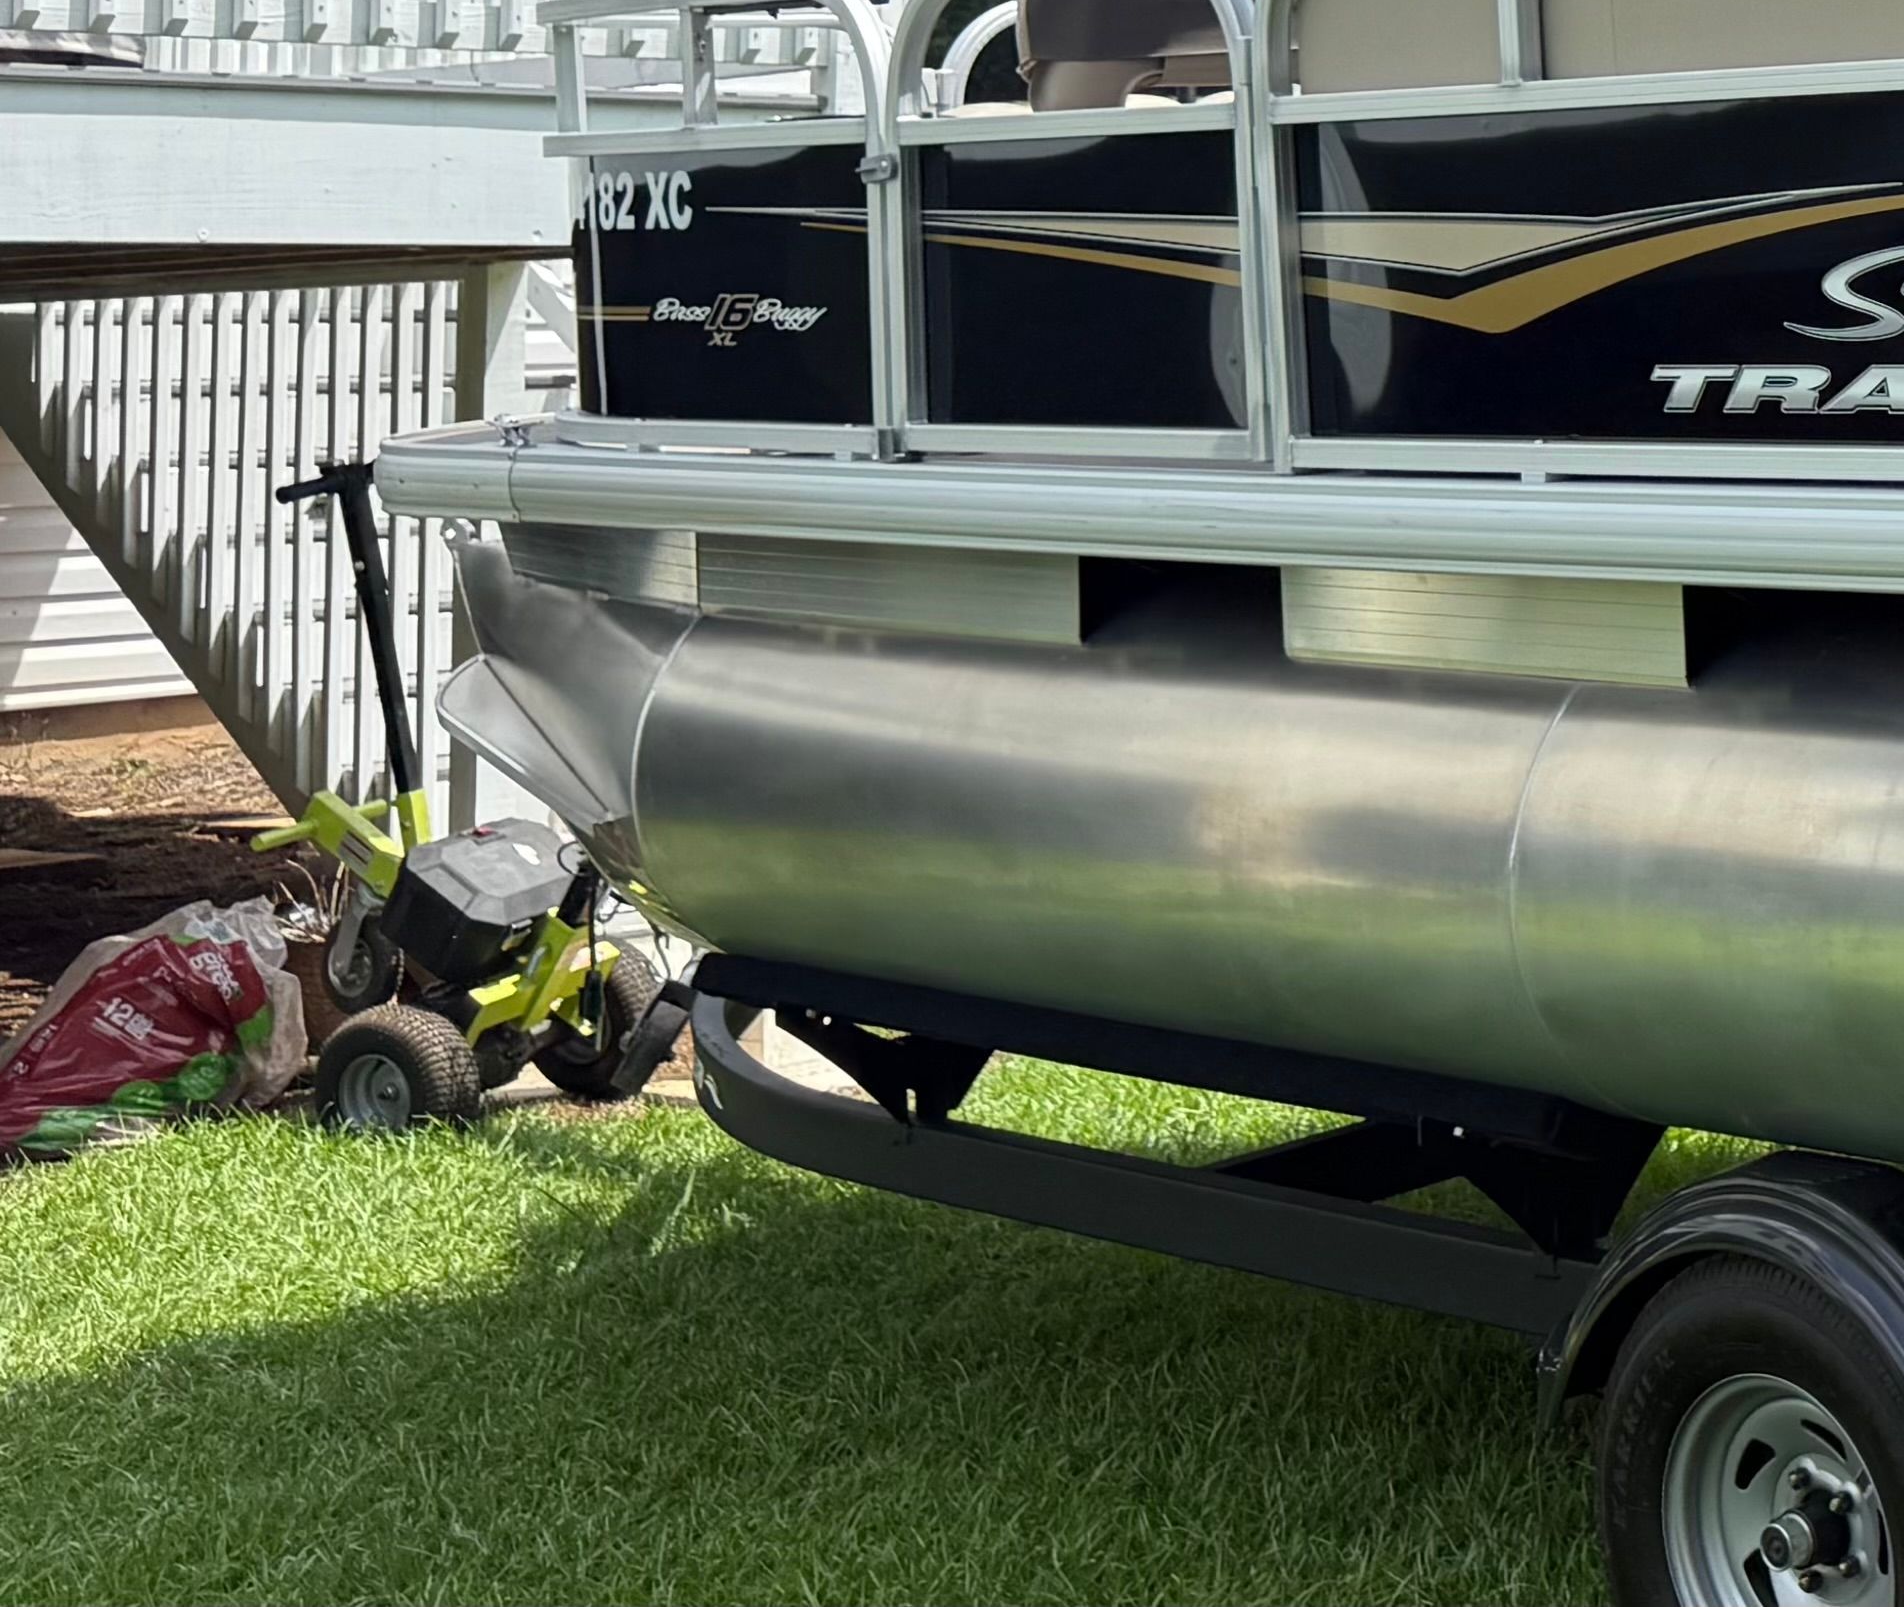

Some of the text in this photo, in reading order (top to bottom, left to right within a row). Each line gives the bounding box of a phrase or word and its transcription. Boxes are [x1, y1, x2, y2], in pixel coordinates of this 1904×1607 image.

[644, 169, 694, 231] XC
[653, 293, 828, 332] Bass 16 Buggy
[706, 332, 739, 347] XL
